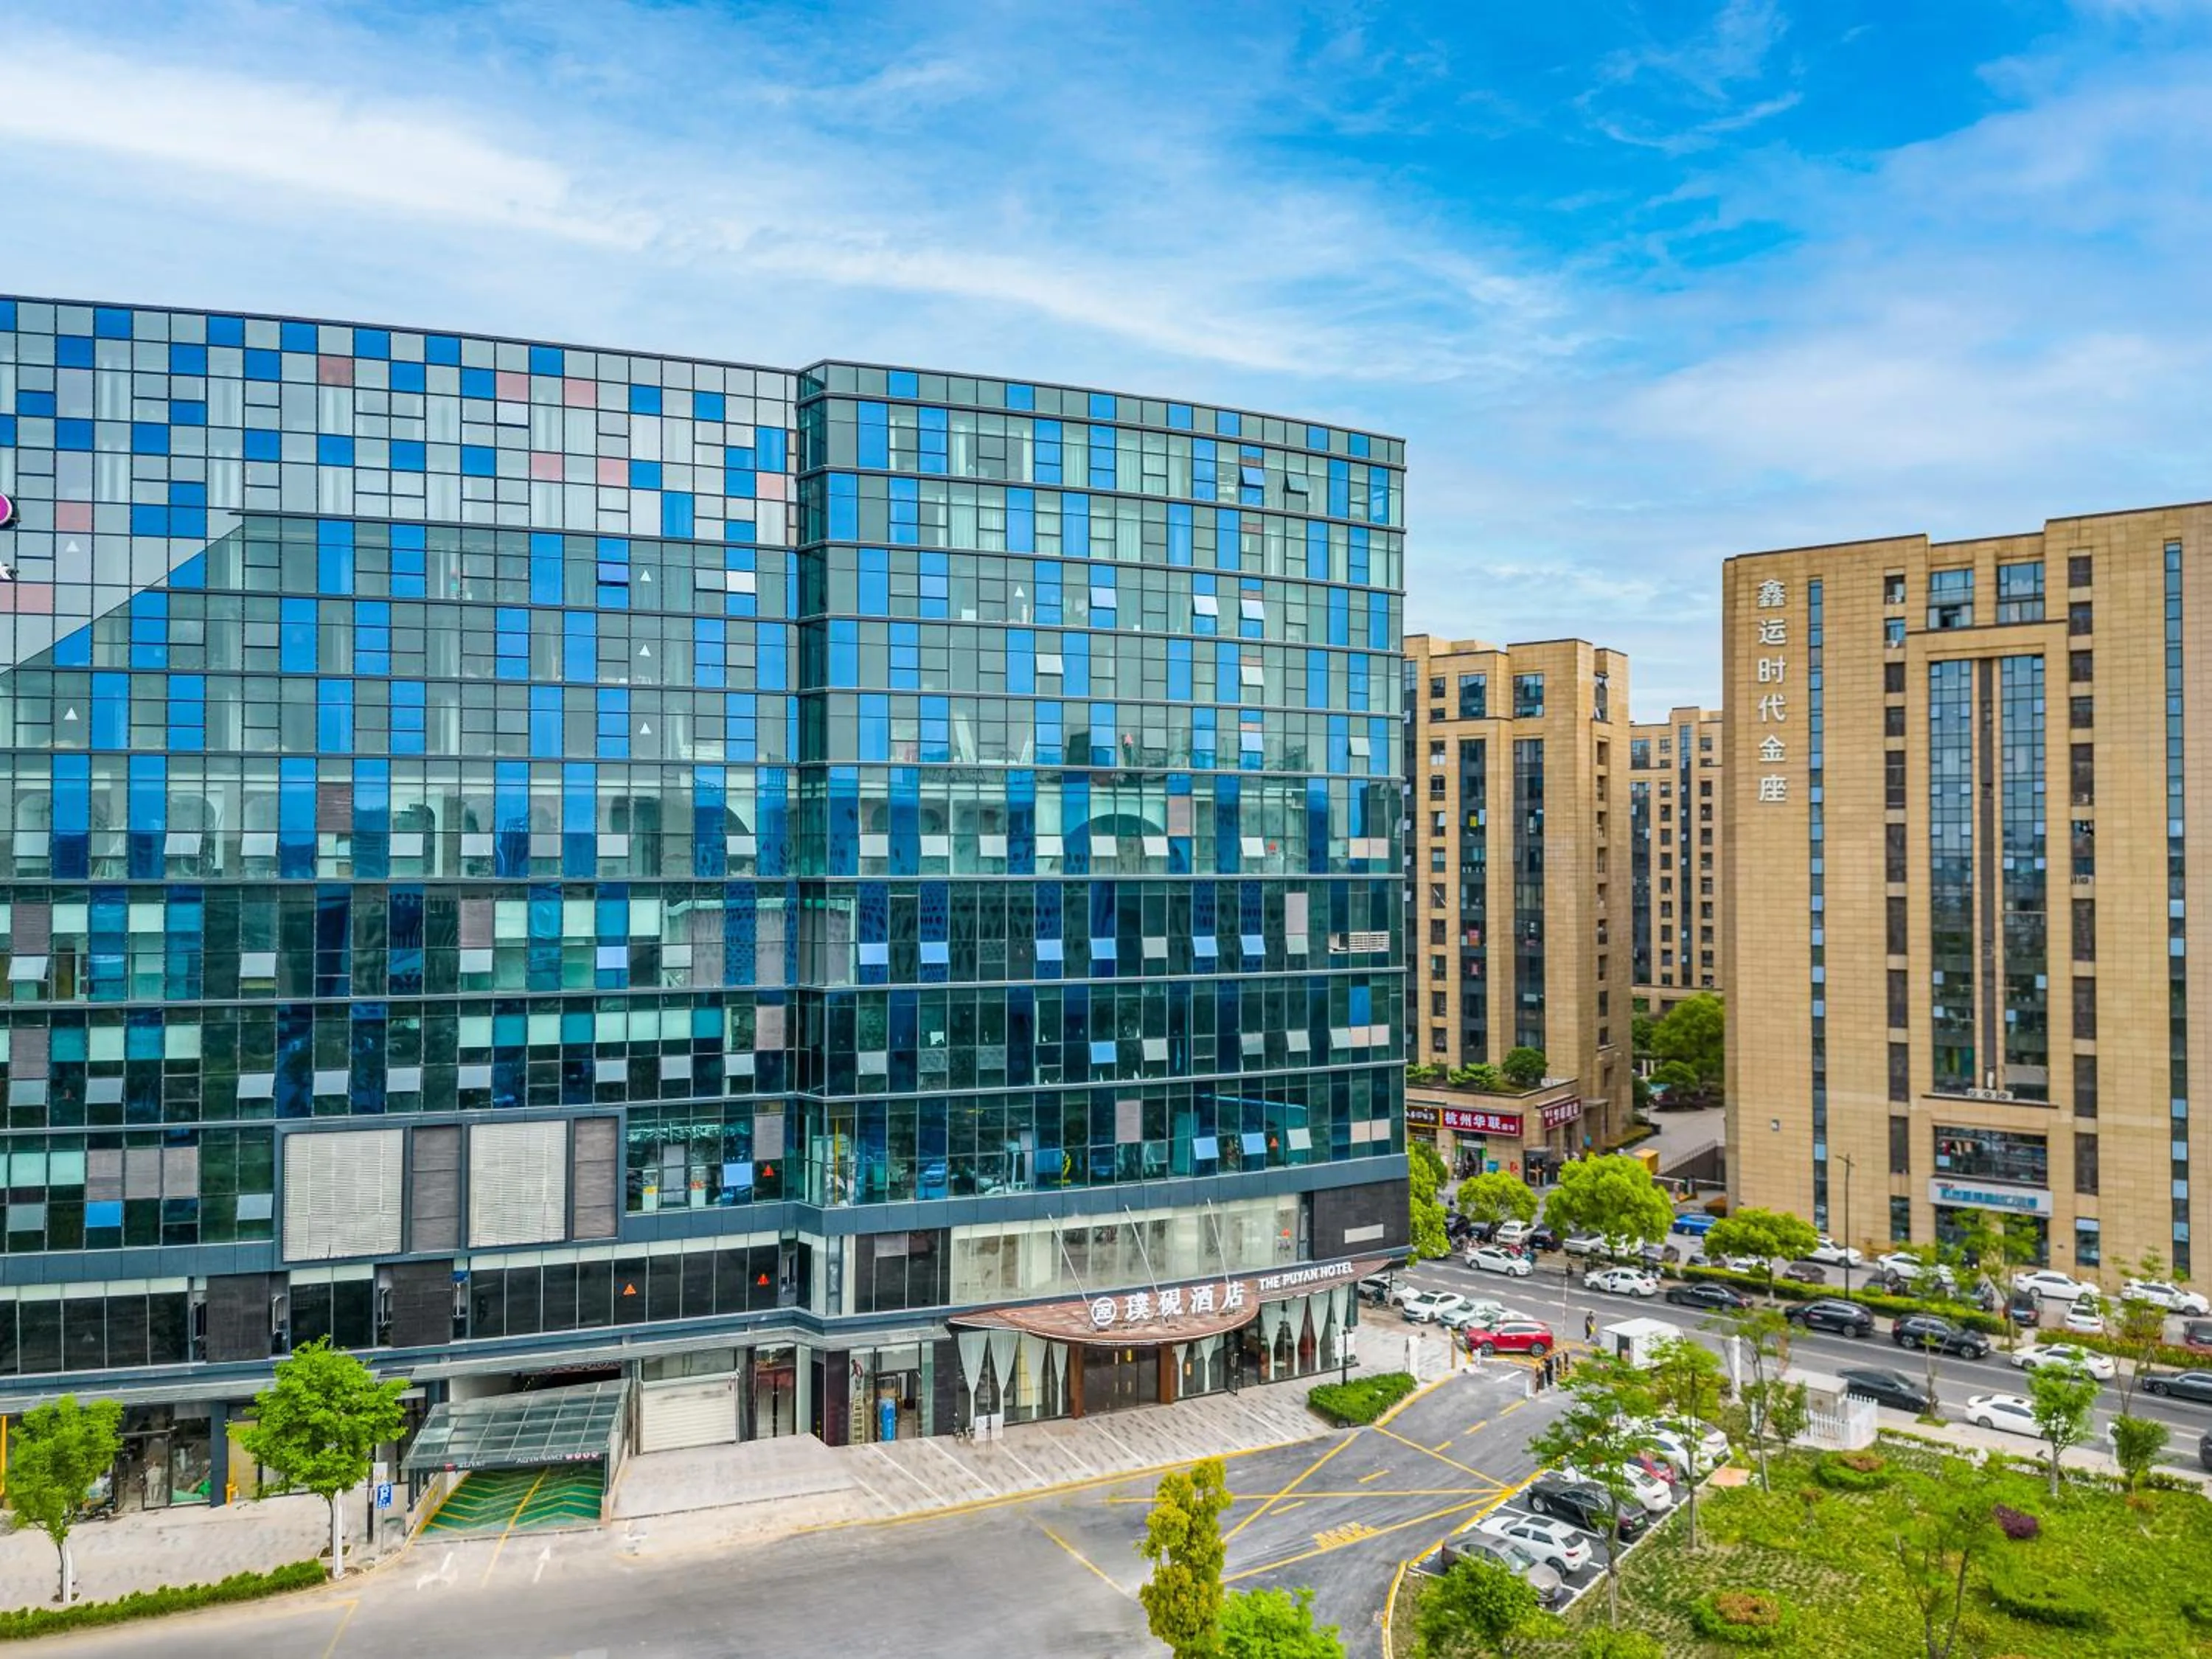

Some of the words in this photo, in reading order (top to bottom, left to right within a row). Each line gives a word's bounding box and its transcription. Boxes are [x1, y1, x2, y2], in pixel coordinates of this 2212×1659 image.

[1758, 579, 1787, 802] 鑫运时代金座
[1259, 1276, 1281, 1290] THE
[1283, 1267, 1318, 1286] PUYAN
[1320, 1262, 1354, 1279] HOTEL
